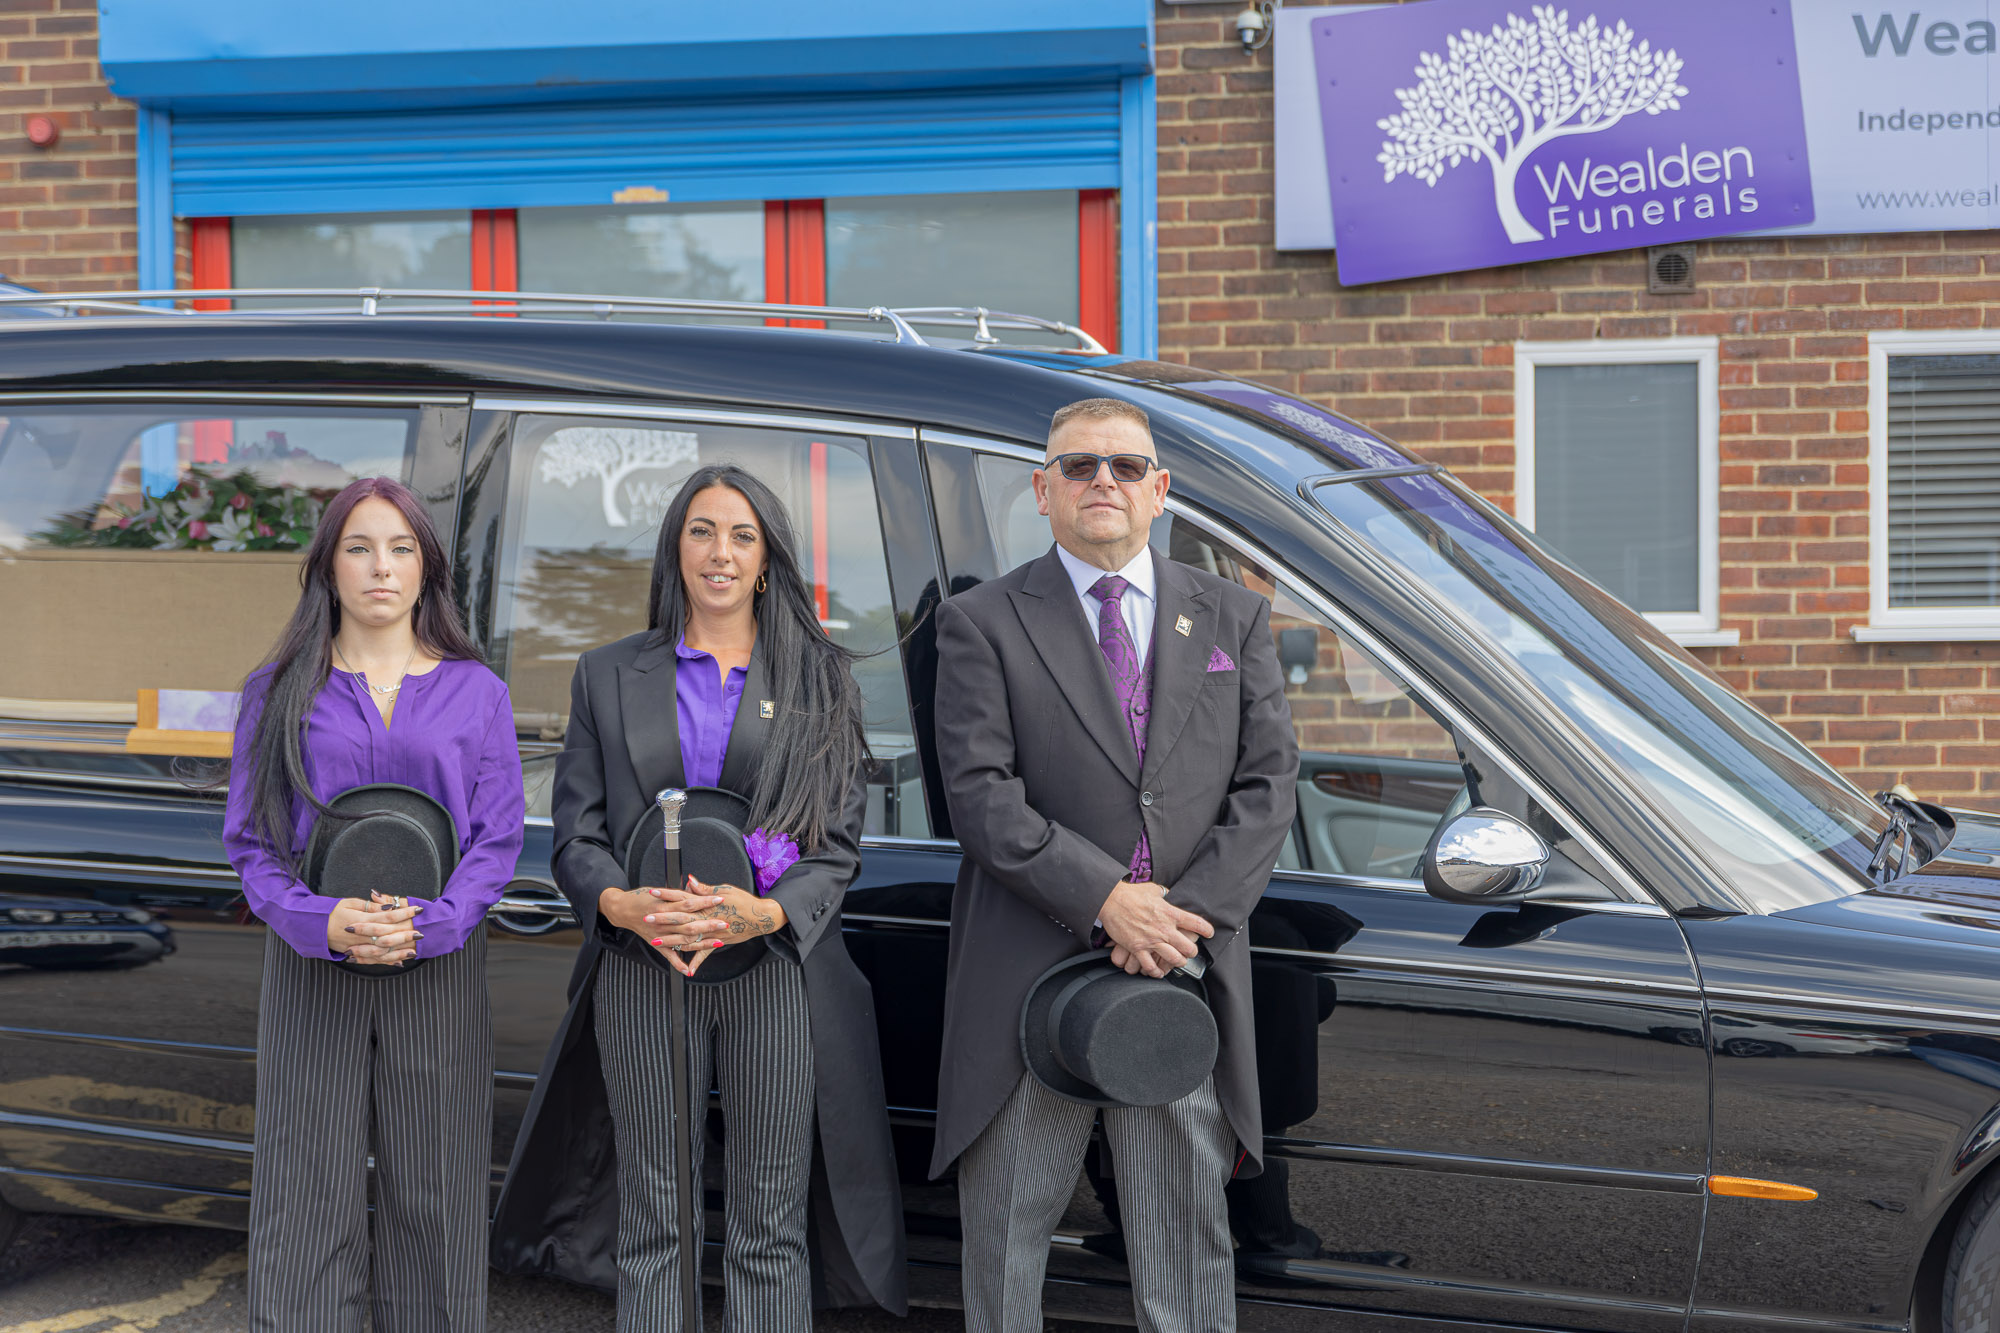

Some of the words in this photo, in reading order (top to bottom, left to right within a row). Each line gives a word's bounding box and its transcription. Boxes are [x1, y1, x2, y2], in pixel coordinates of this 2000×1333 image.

[1852, 12, 1997, 57] Wea
[1534, 142, 1755, 204] Wealden
[1856, 182, 1999, 209] www.weal
[1548, 182, 1759, 239] Funerals
